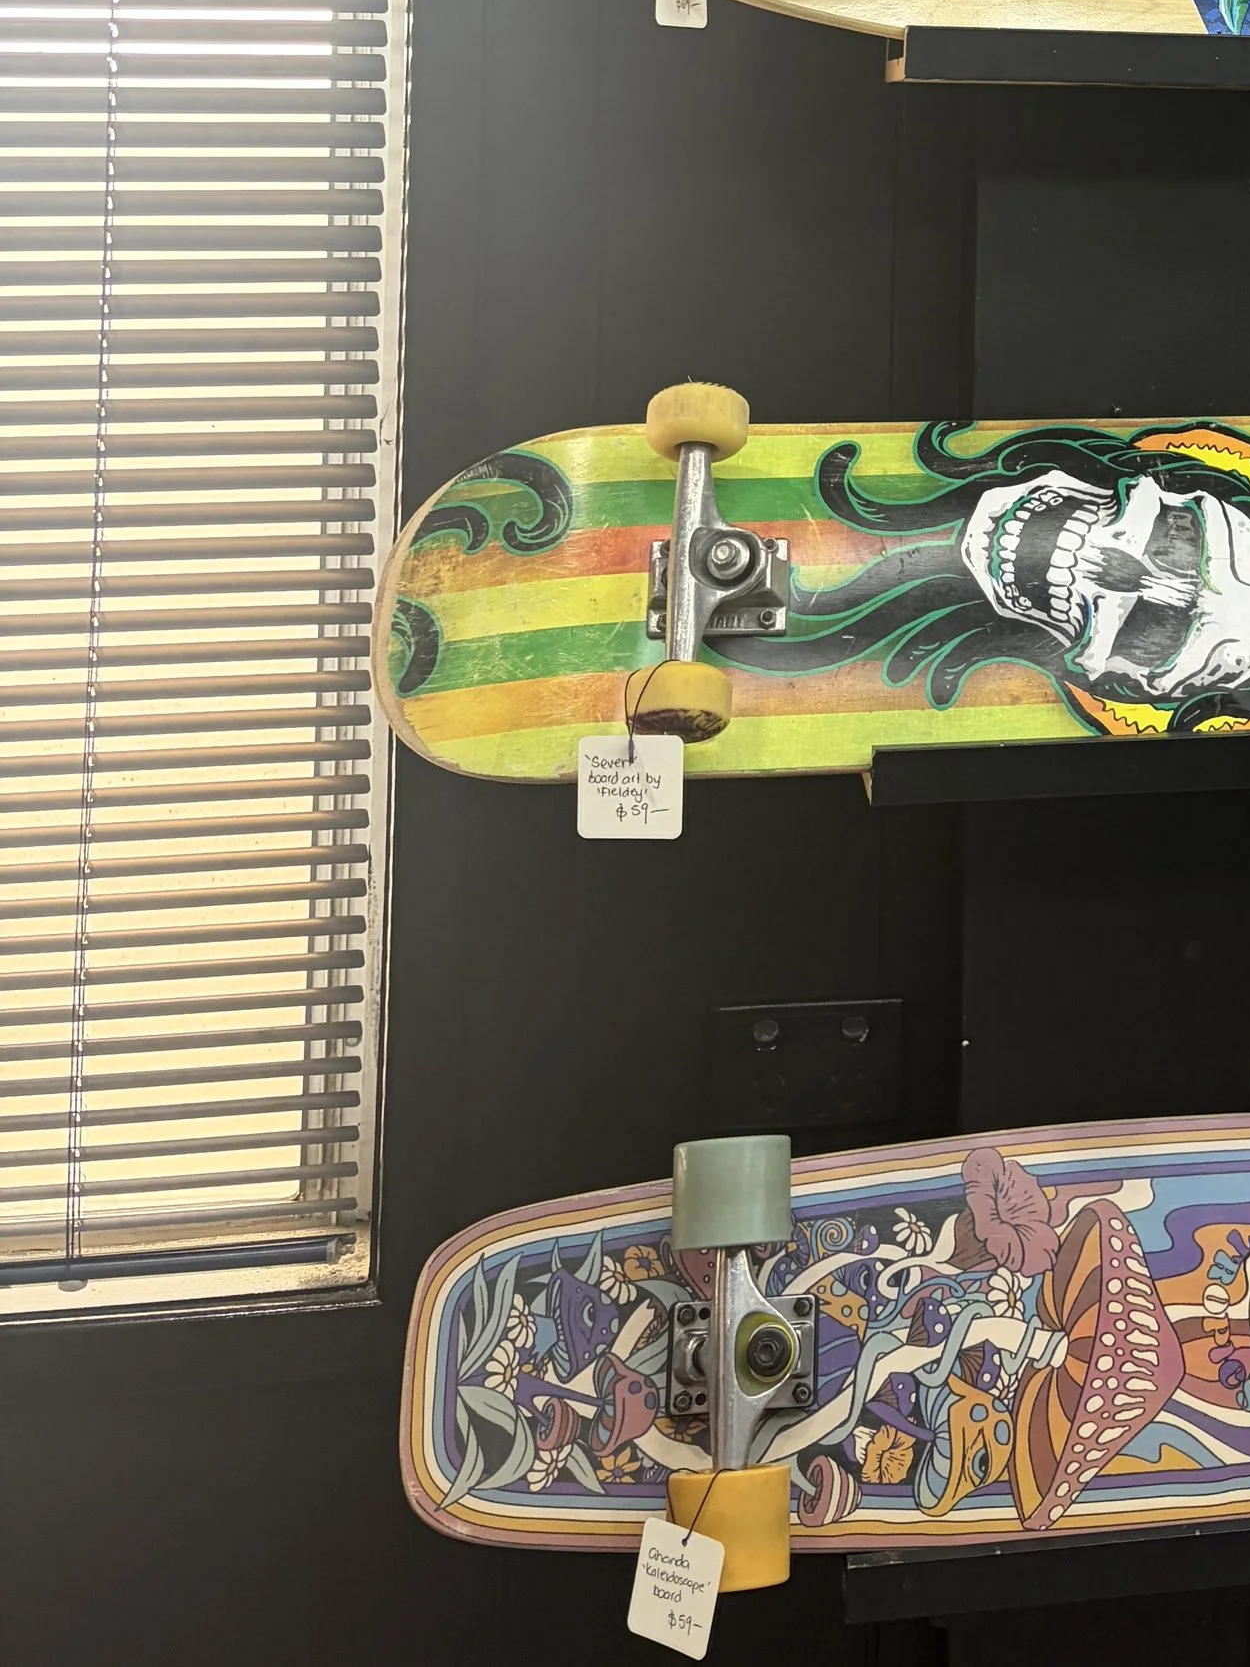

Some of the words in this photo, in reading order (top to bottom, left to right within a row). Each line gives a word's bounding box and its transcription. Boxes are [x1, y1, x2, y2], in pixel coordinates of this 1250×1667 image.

[588, 771, 619, 785] board
[621, 772, 641, 785] art
[645, 772, 662, 790] by
[653, 1584, 682, 1603] board
